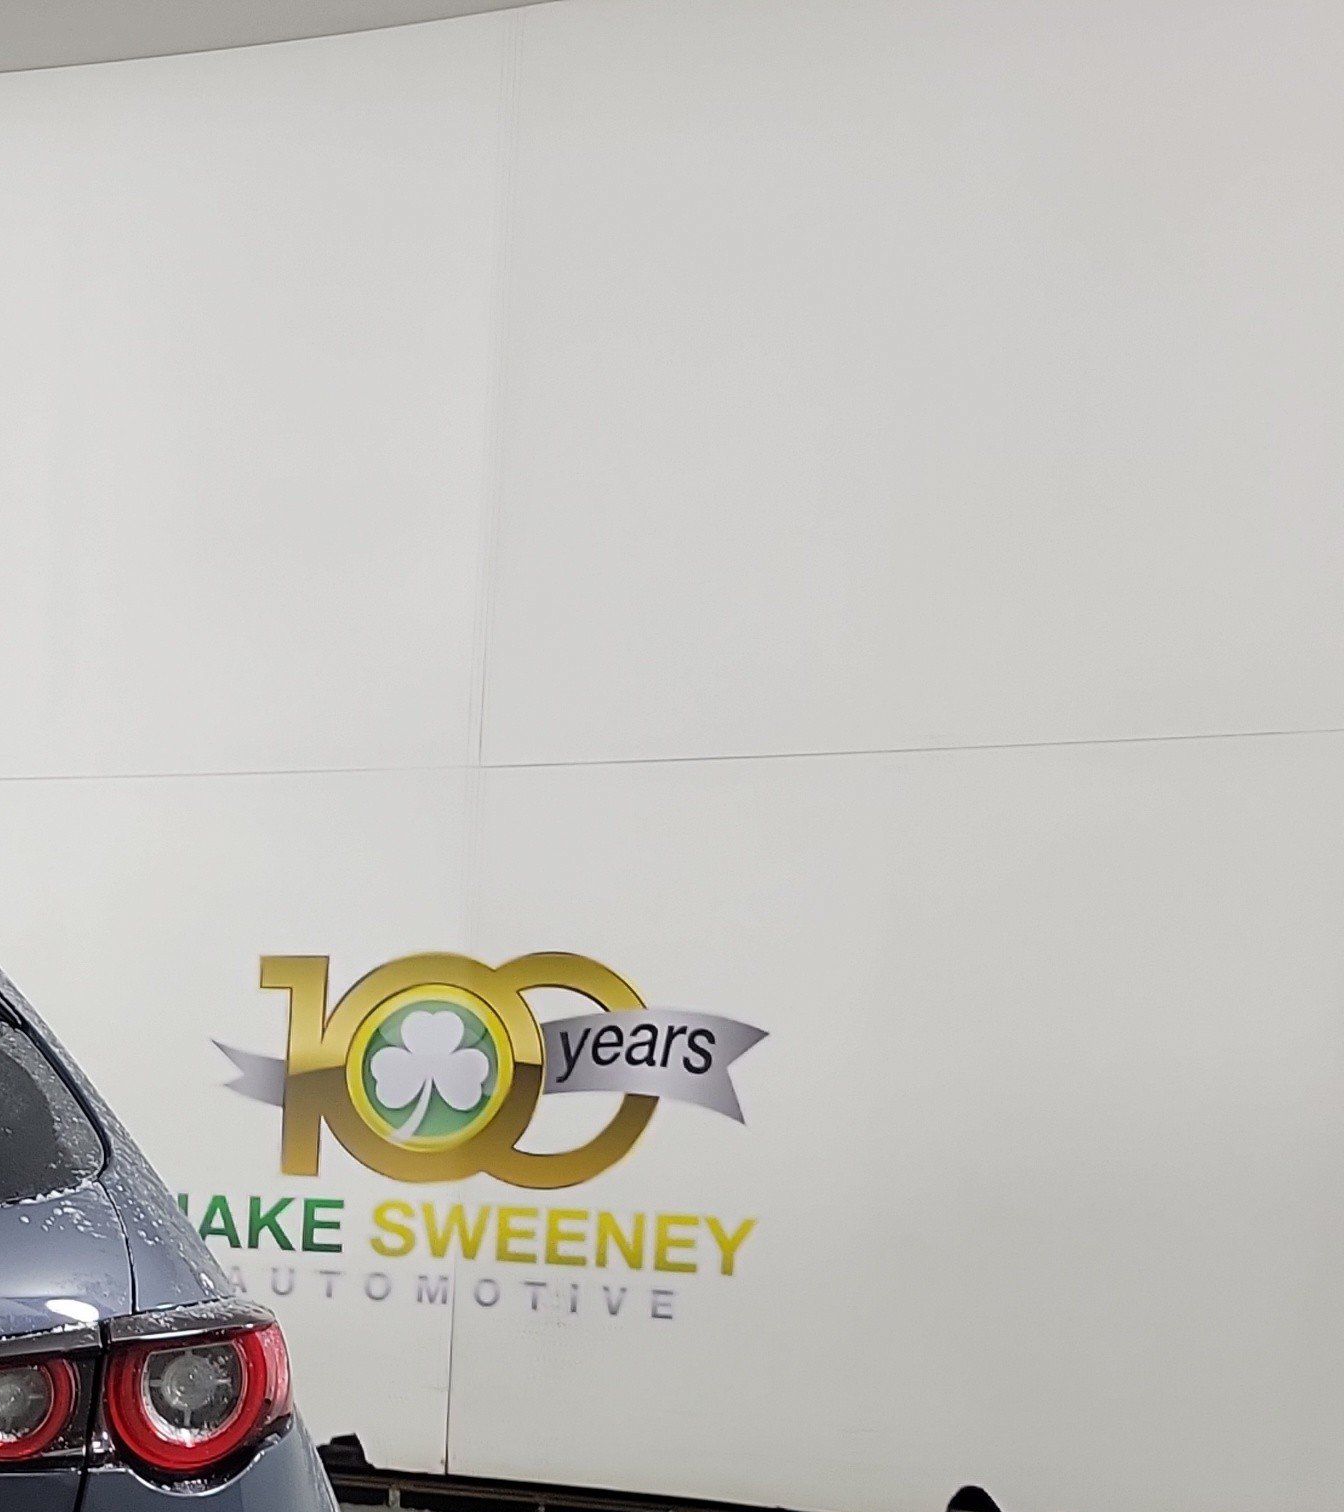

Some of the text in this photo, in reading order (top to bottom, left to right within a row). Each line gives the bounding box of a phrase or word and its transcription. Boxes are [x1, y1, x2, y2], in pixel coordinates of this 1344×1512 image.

[555, 1023, 715, 1083] years
[369, 1200, 757, 1277] SWEENEY
[229, 1266, 676, 1321] AUTOMOTIVE
